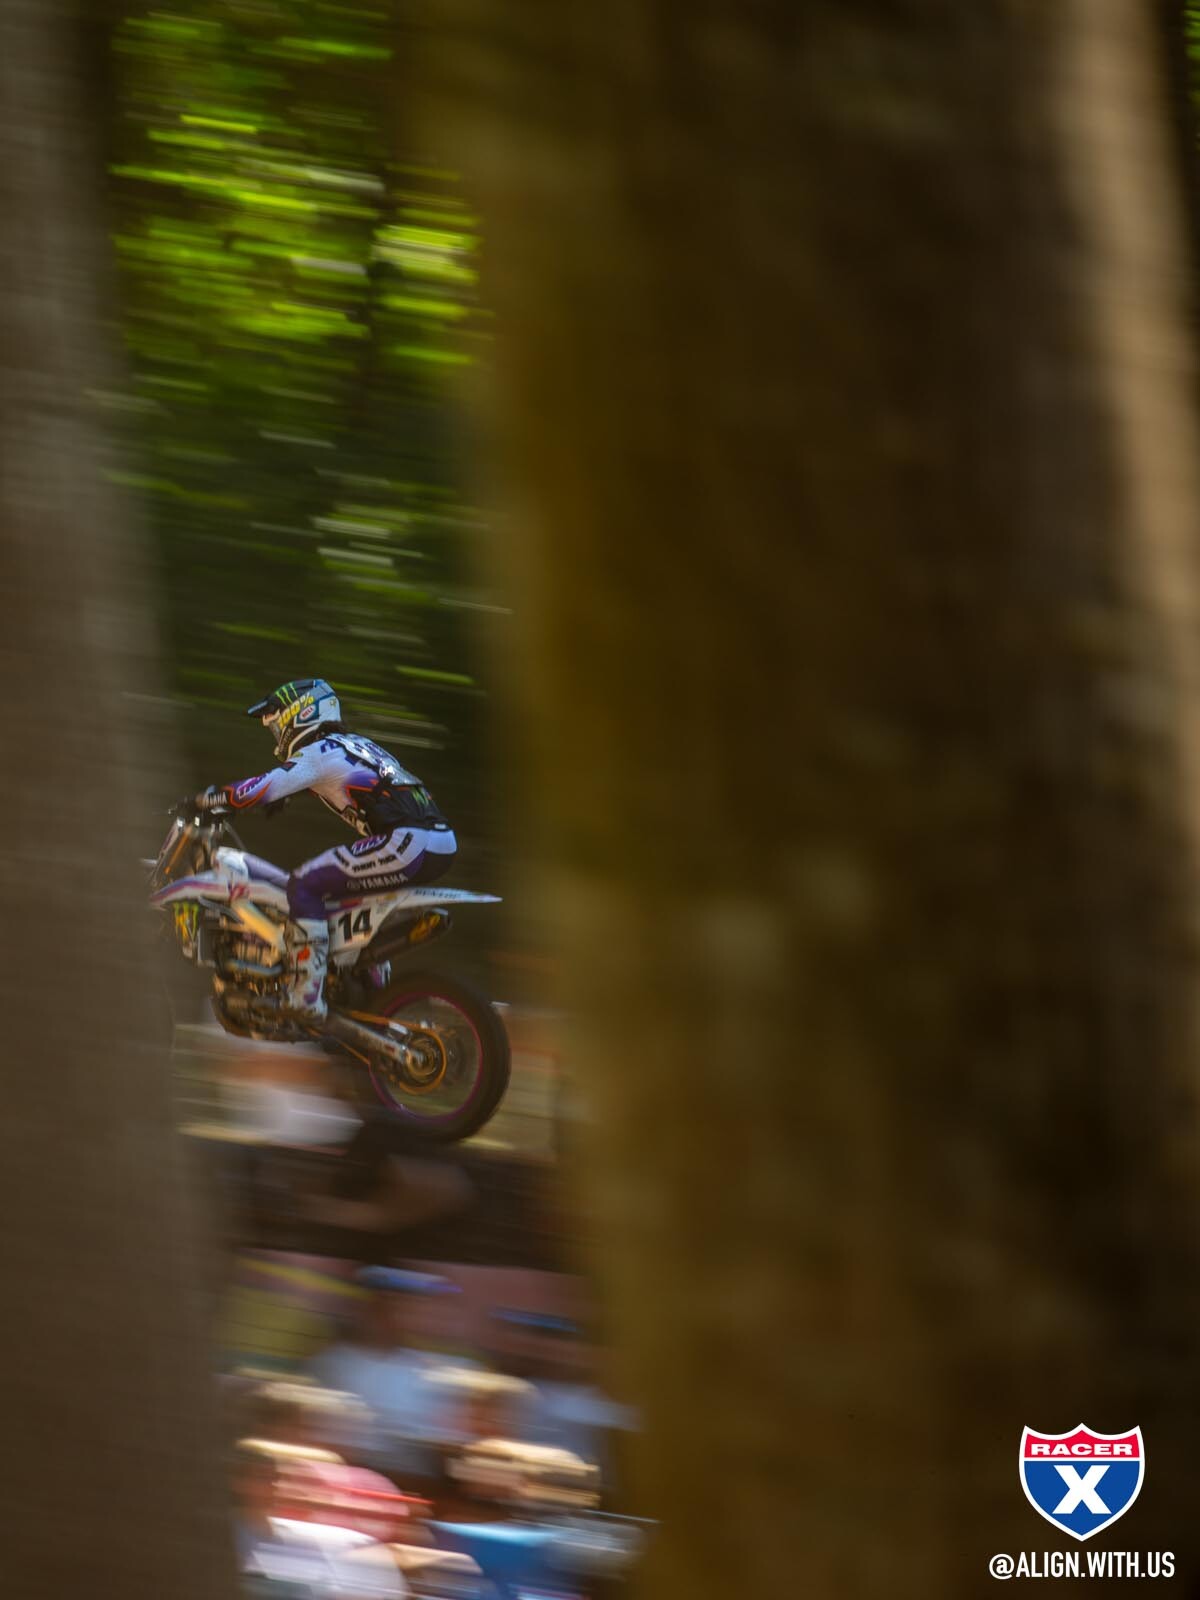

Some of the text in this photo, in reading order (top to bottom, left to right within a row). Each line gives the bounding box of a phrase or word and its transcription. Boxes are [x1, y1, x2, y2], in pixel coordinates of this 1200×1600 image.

[278, 691, 314, 728] 100%
[359, 872, 407, 889] YAMAHA
[338, 908, 372, 943] 14
